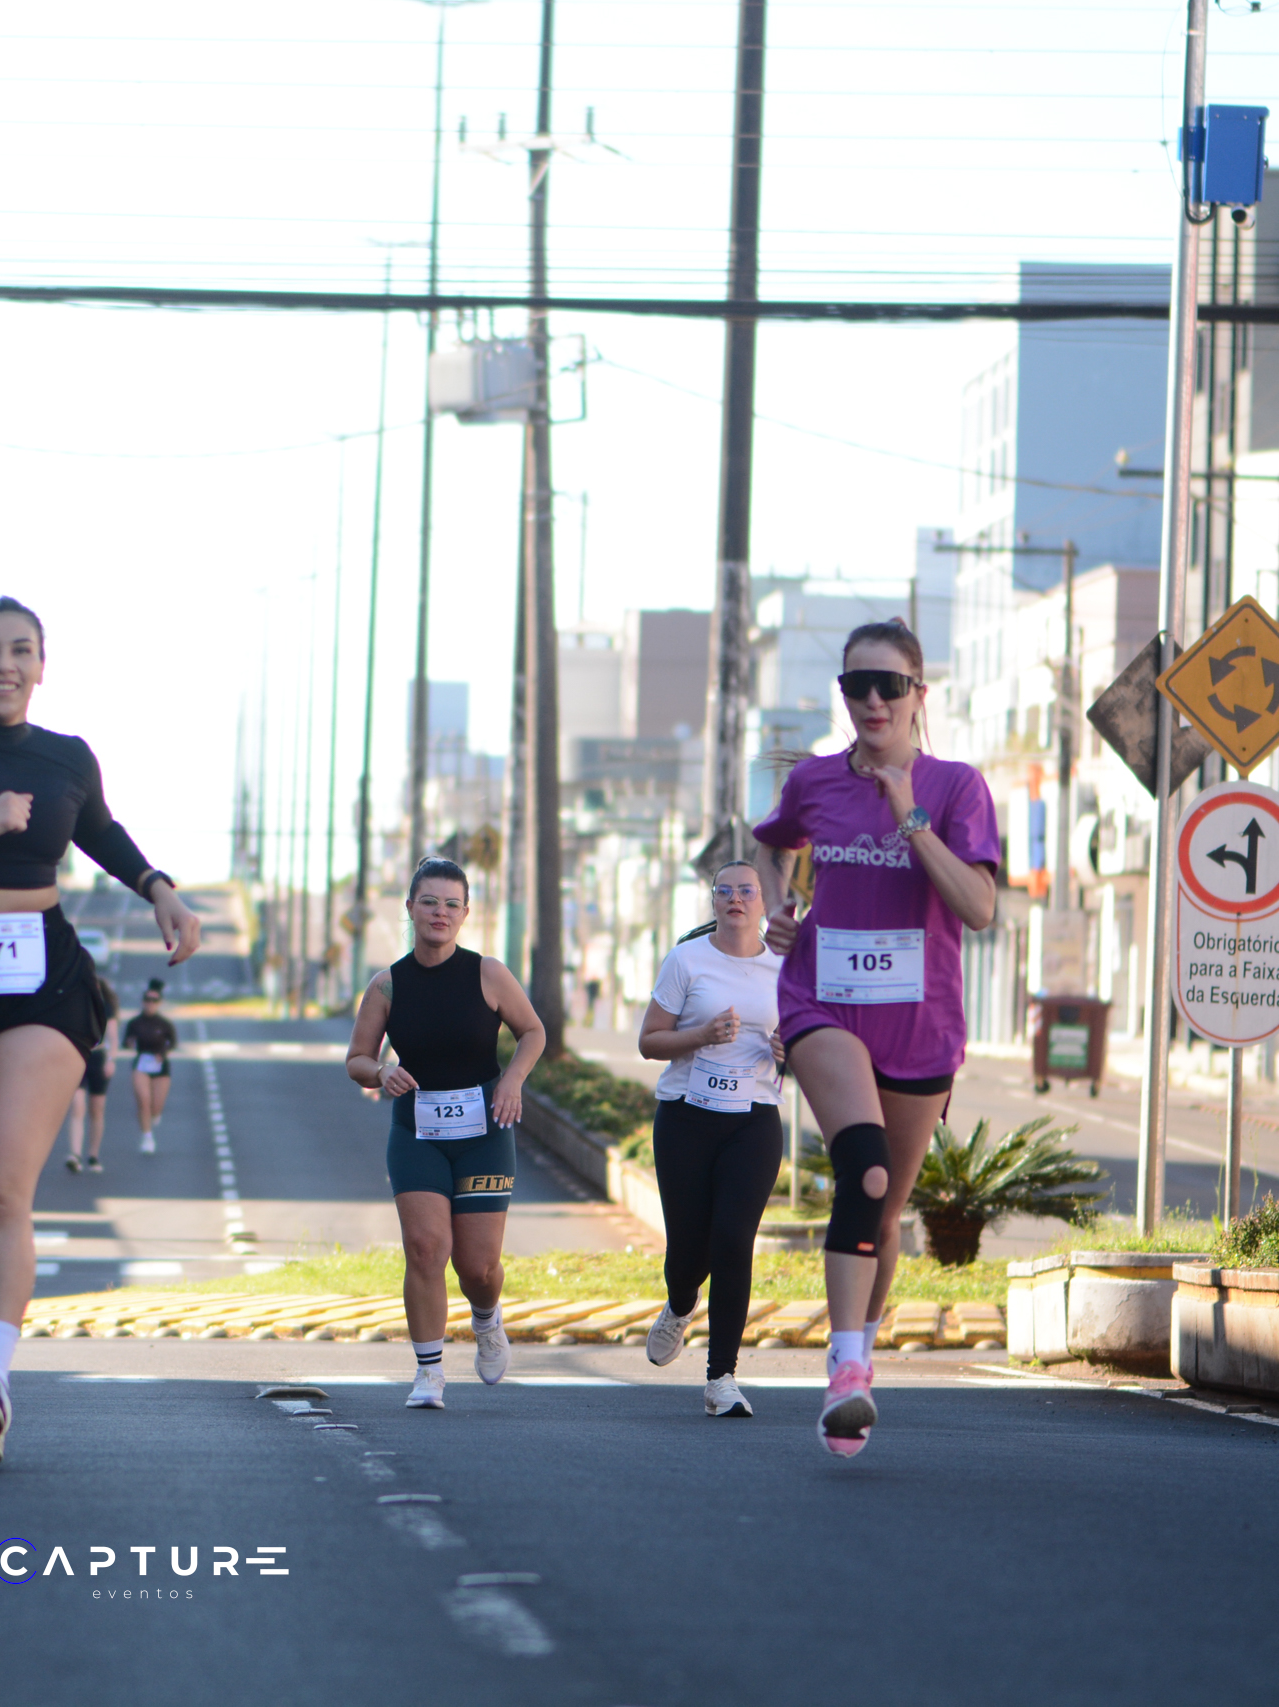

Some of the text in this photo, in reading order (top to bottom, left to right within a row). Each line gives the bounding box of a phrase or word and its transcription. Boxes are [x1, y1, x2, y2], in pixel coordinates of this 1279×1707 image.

[813, 845, 912, 869] PODEROSA
[847, 953, 893, 971] 105
[1189, 962, 1223, 980] para
[1228, 964, 1237, 978] a
[1186, 985, 1205, 1003] da
[707, 1076, 738, 1091] 053
[434, 1105, 464, 1118] 123
